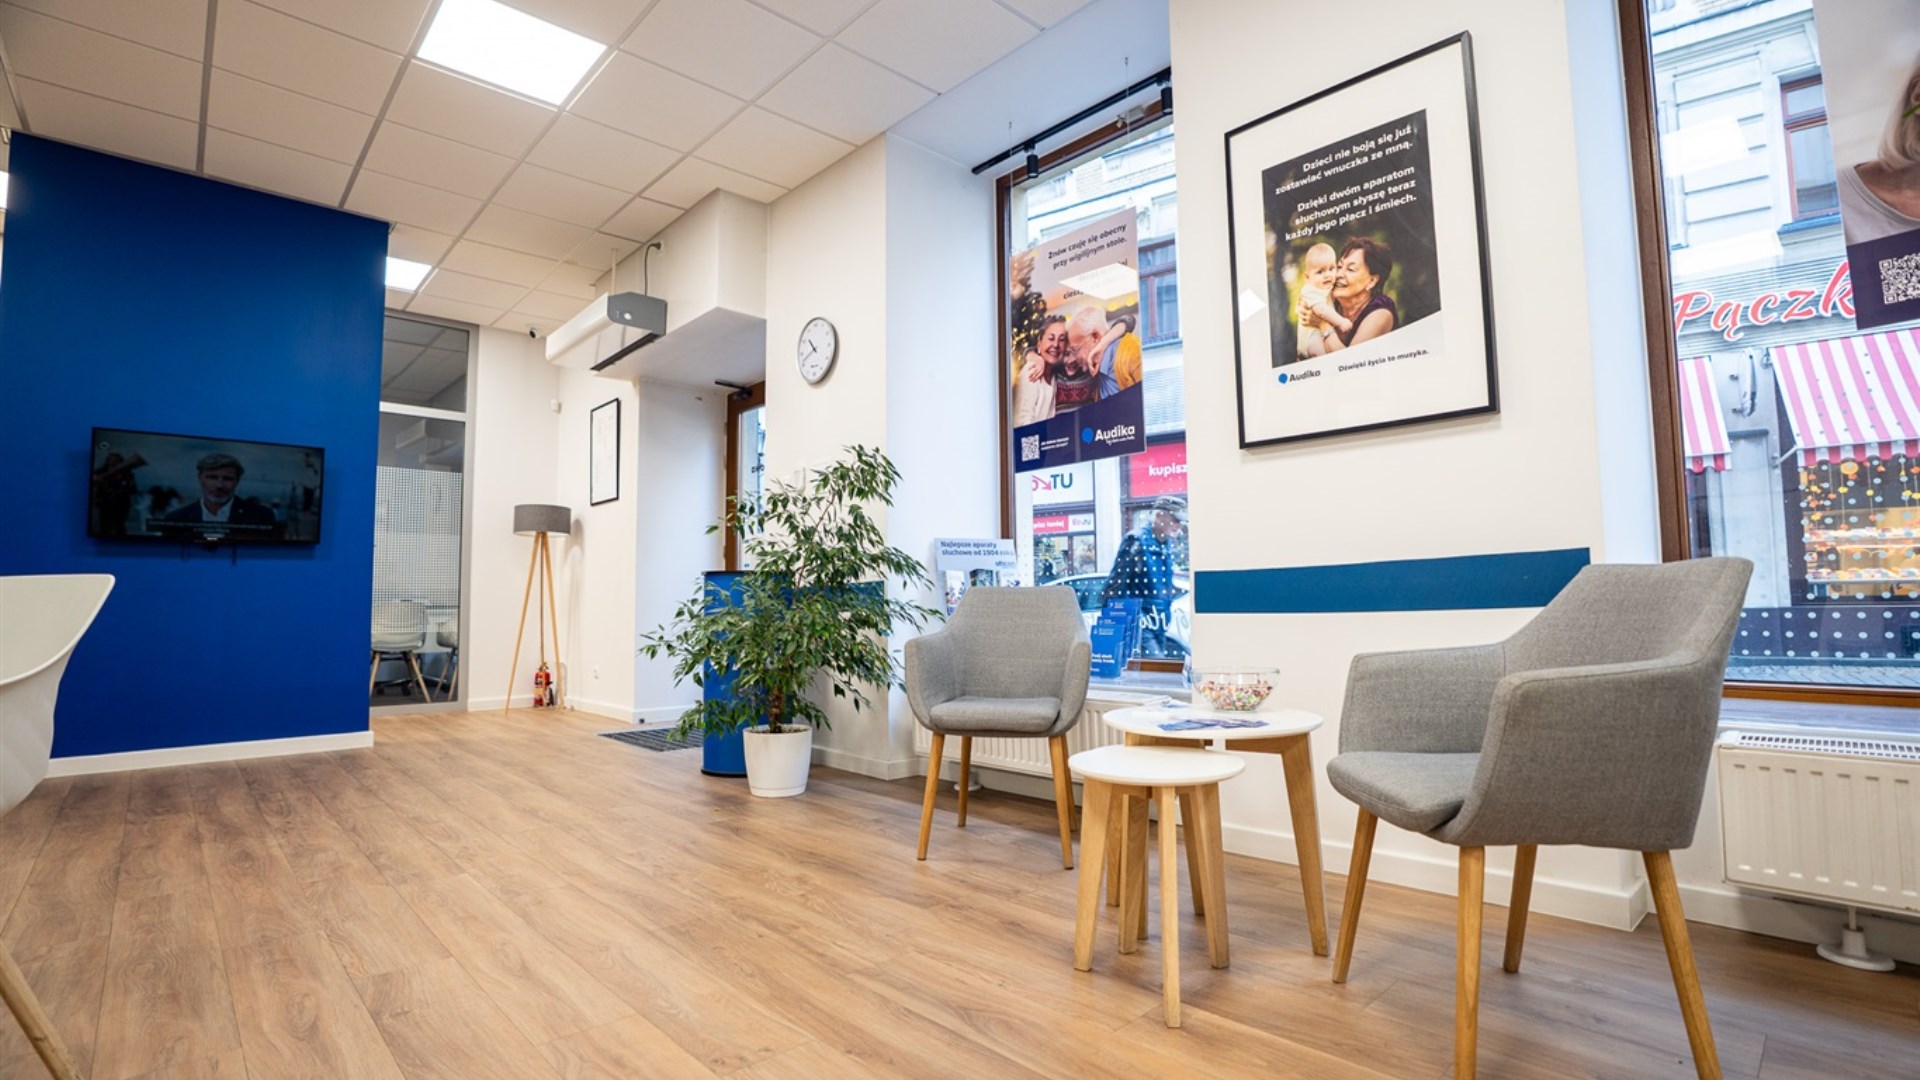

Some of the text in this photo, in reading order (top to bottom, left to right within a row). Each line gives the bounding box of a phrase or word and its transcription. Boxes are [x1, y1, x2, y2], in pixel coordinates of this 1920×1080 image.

[1303, 124, 1412, 172] Dzieci nie boją się już
[1275, 142, 1413, 195] zostawiać wnuczka ze mną.
[1295, 180, 1416, 226] słuchowym słyszę teraz
[1297, 166, 1415, 212] Dzięki dwóm aparatom
[1285, 226, 1314, 242] każdy
[1314, 220, 1338, 234] jego
[1339, 210, 1367, 226] płacz
[1374, 194, 1417, 213] śmiech.
[1048, 224, 1127, 259] Znów czuję się obecny
[1053, 259, 1068, 270] przy
[1069, 244, 1105, 262] wigilijnym
[1289, 368, 1321, 382] Audika
[1338, 362, 1366, 372] Dźwięki
[1368, 358, 1386, 367] życia
[1397, 349, 1429, 360] muzyka.
[1094, 424, 1135, 442] Audika
[1148, 464, 1187, 478] kupisz
